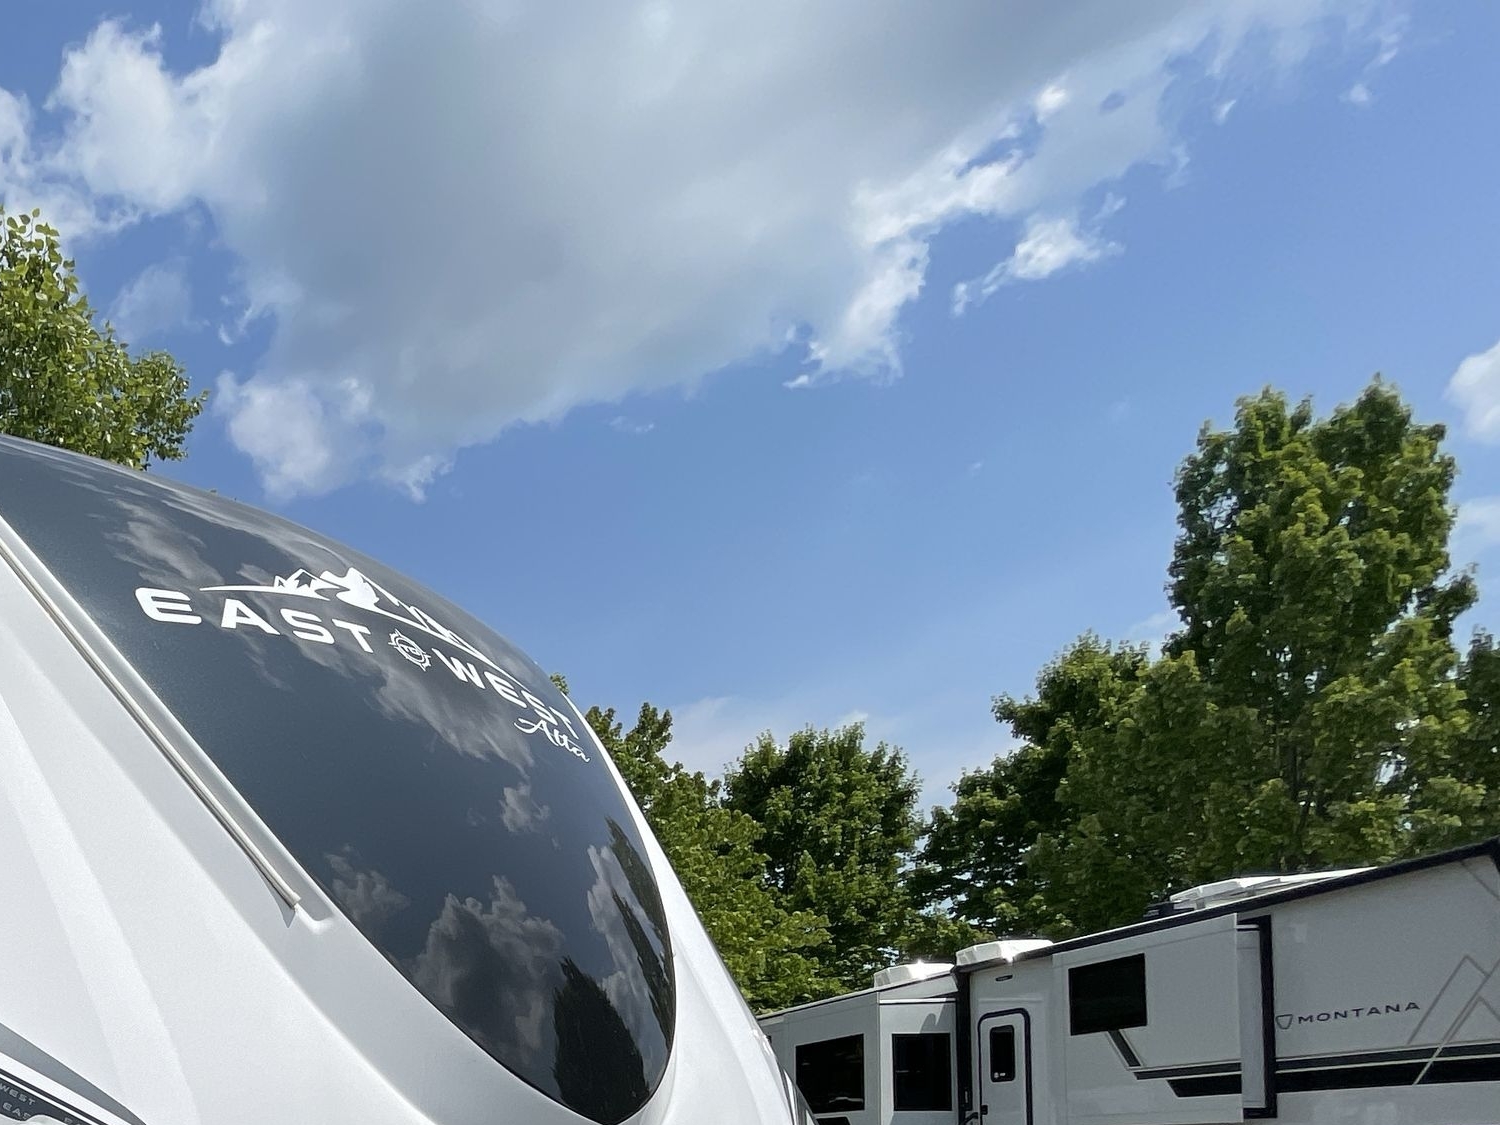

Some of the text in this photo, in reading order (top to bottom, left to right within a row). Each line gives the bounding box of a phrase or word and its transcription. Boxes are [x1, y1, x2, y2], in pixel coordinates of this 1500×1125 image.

[134, 587, 374, 653] EAST
[431, 647, 580, 740] WEST
[513, 717, 591, 763] Alta
[1298, 1002, 1421, 1024] MONTANA
[0, 1083, 36, 1106] WEST
